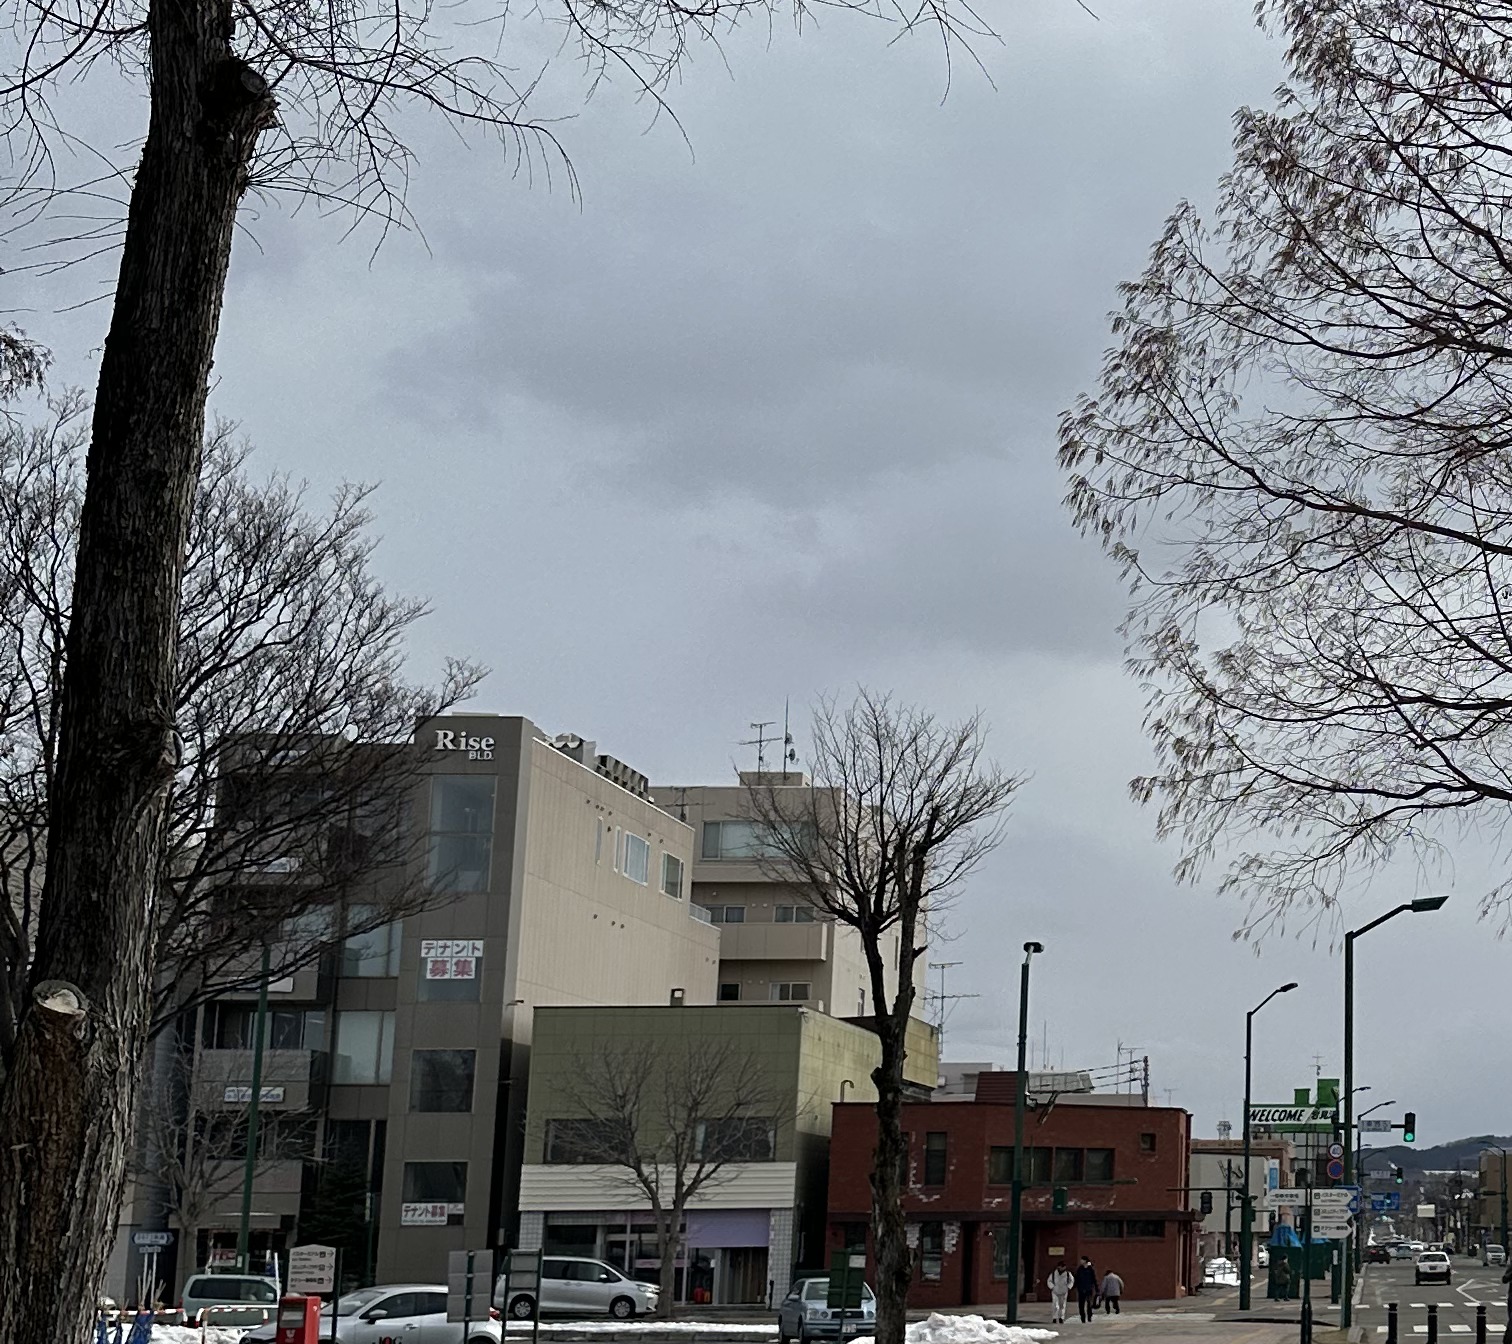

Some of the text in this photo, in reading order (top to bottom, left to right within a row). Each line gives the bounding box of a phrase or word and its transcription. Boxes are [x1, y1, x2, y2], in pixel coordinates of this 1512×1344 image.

[434, 729, 495, 750] Rise
[423, 943, 480, 955] テナント
[429, 959, 473, 977] 募集
[1250, 1109, 1305, 1122] WELCOME
